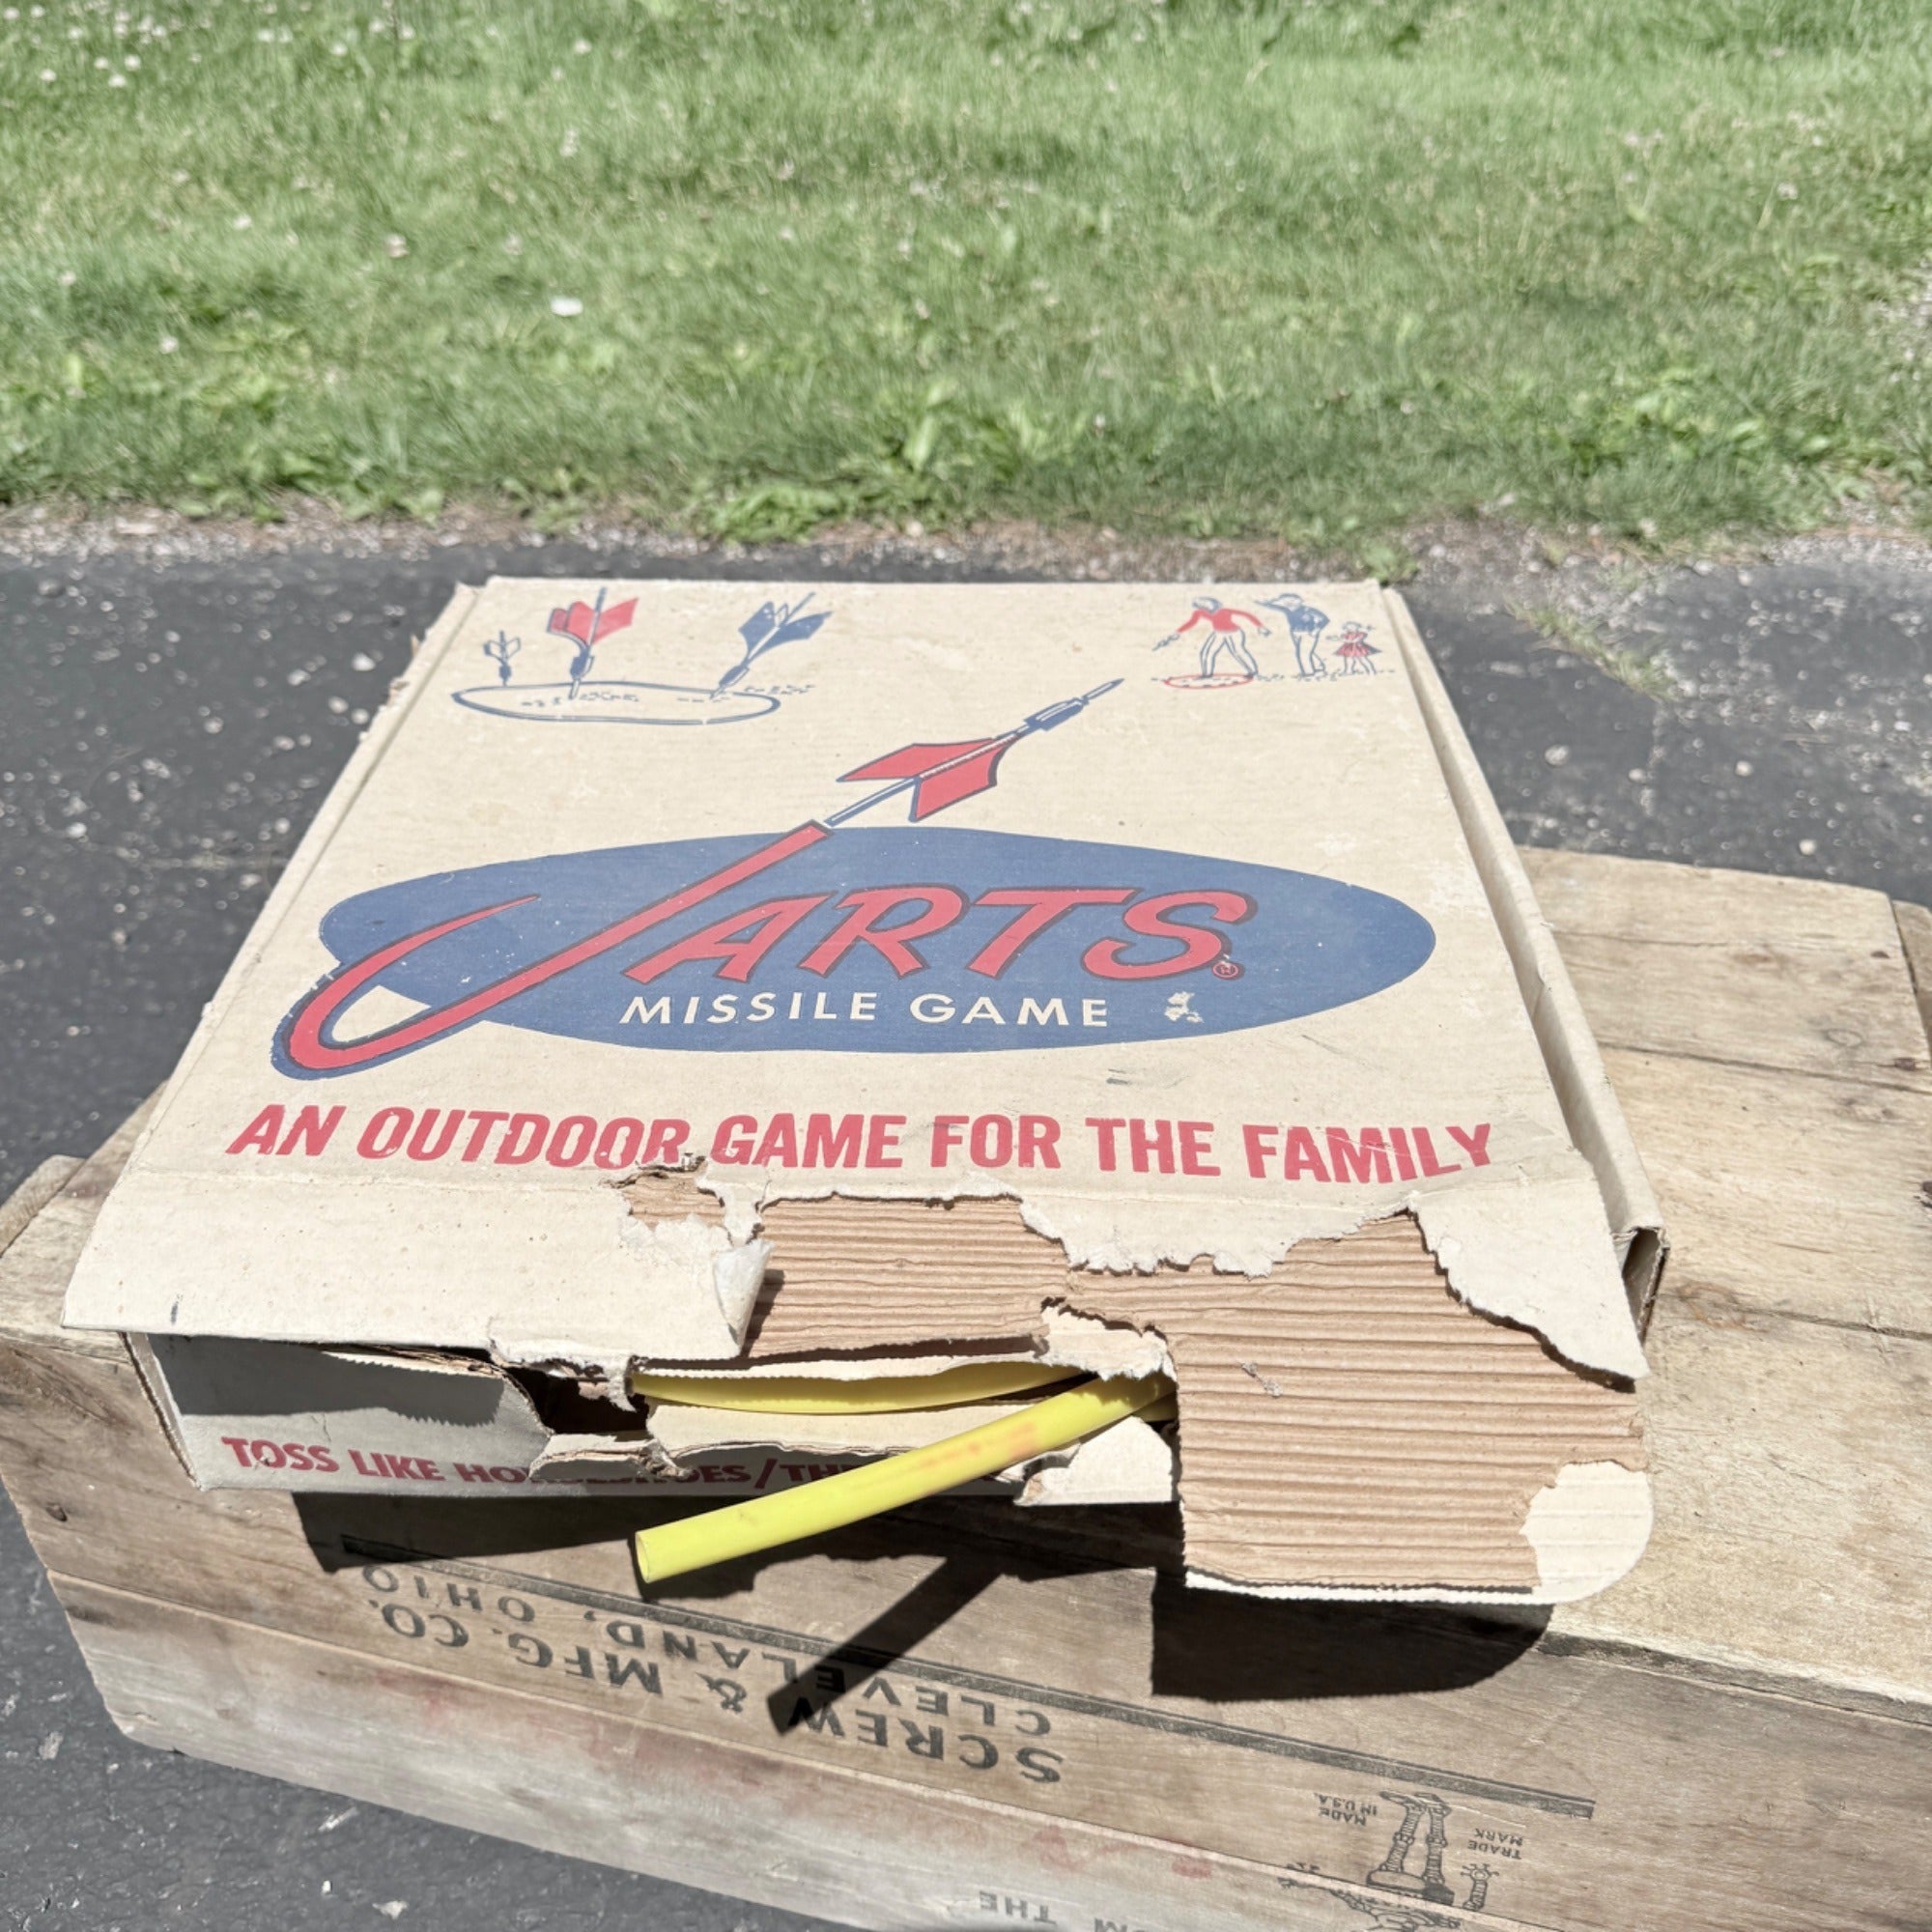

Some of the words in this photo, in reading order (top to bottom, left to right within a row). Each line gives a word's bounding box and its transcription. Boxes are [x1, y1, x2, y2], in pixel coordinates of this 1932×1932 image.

[619, 991, 878, 1025] MISSILE
[910, 993, 1110, 1027] GAME
[226, 1104, 346, 1156] AN
[356, 1106, 692, 1170] OUTDOOR
[710, 1114, 907, 1169] GAME
[931, 1114, 1061, 1169] FOR
[1085, 1118, 1221, 1177] THE
[1242, 1122, 1492, 1184] FAMILY
[221, 1436, 340, 1474] TOSS
[349, 1450, 444, 1481] LIKE
[362, 1564, 535, 1623] OHIO
[368, 1598, 469, 1647] CO.
[492, 1628, 663, 1695] MFG.
[583, 1609, 1051, 1737] CLEVELAND,
[696, 1672, 748, 1713] &
[786, 1697, 1064, 1783] SCREW
[1319, 1806, 1368, 1827] MADE
[1358, 1804, 1378, 1817] IN
[1467, 1839, 1522, 1861] TRADE
[1474, 1827, 1524, 1847] MARK
[979, 1890, 1057, 1925] THE
